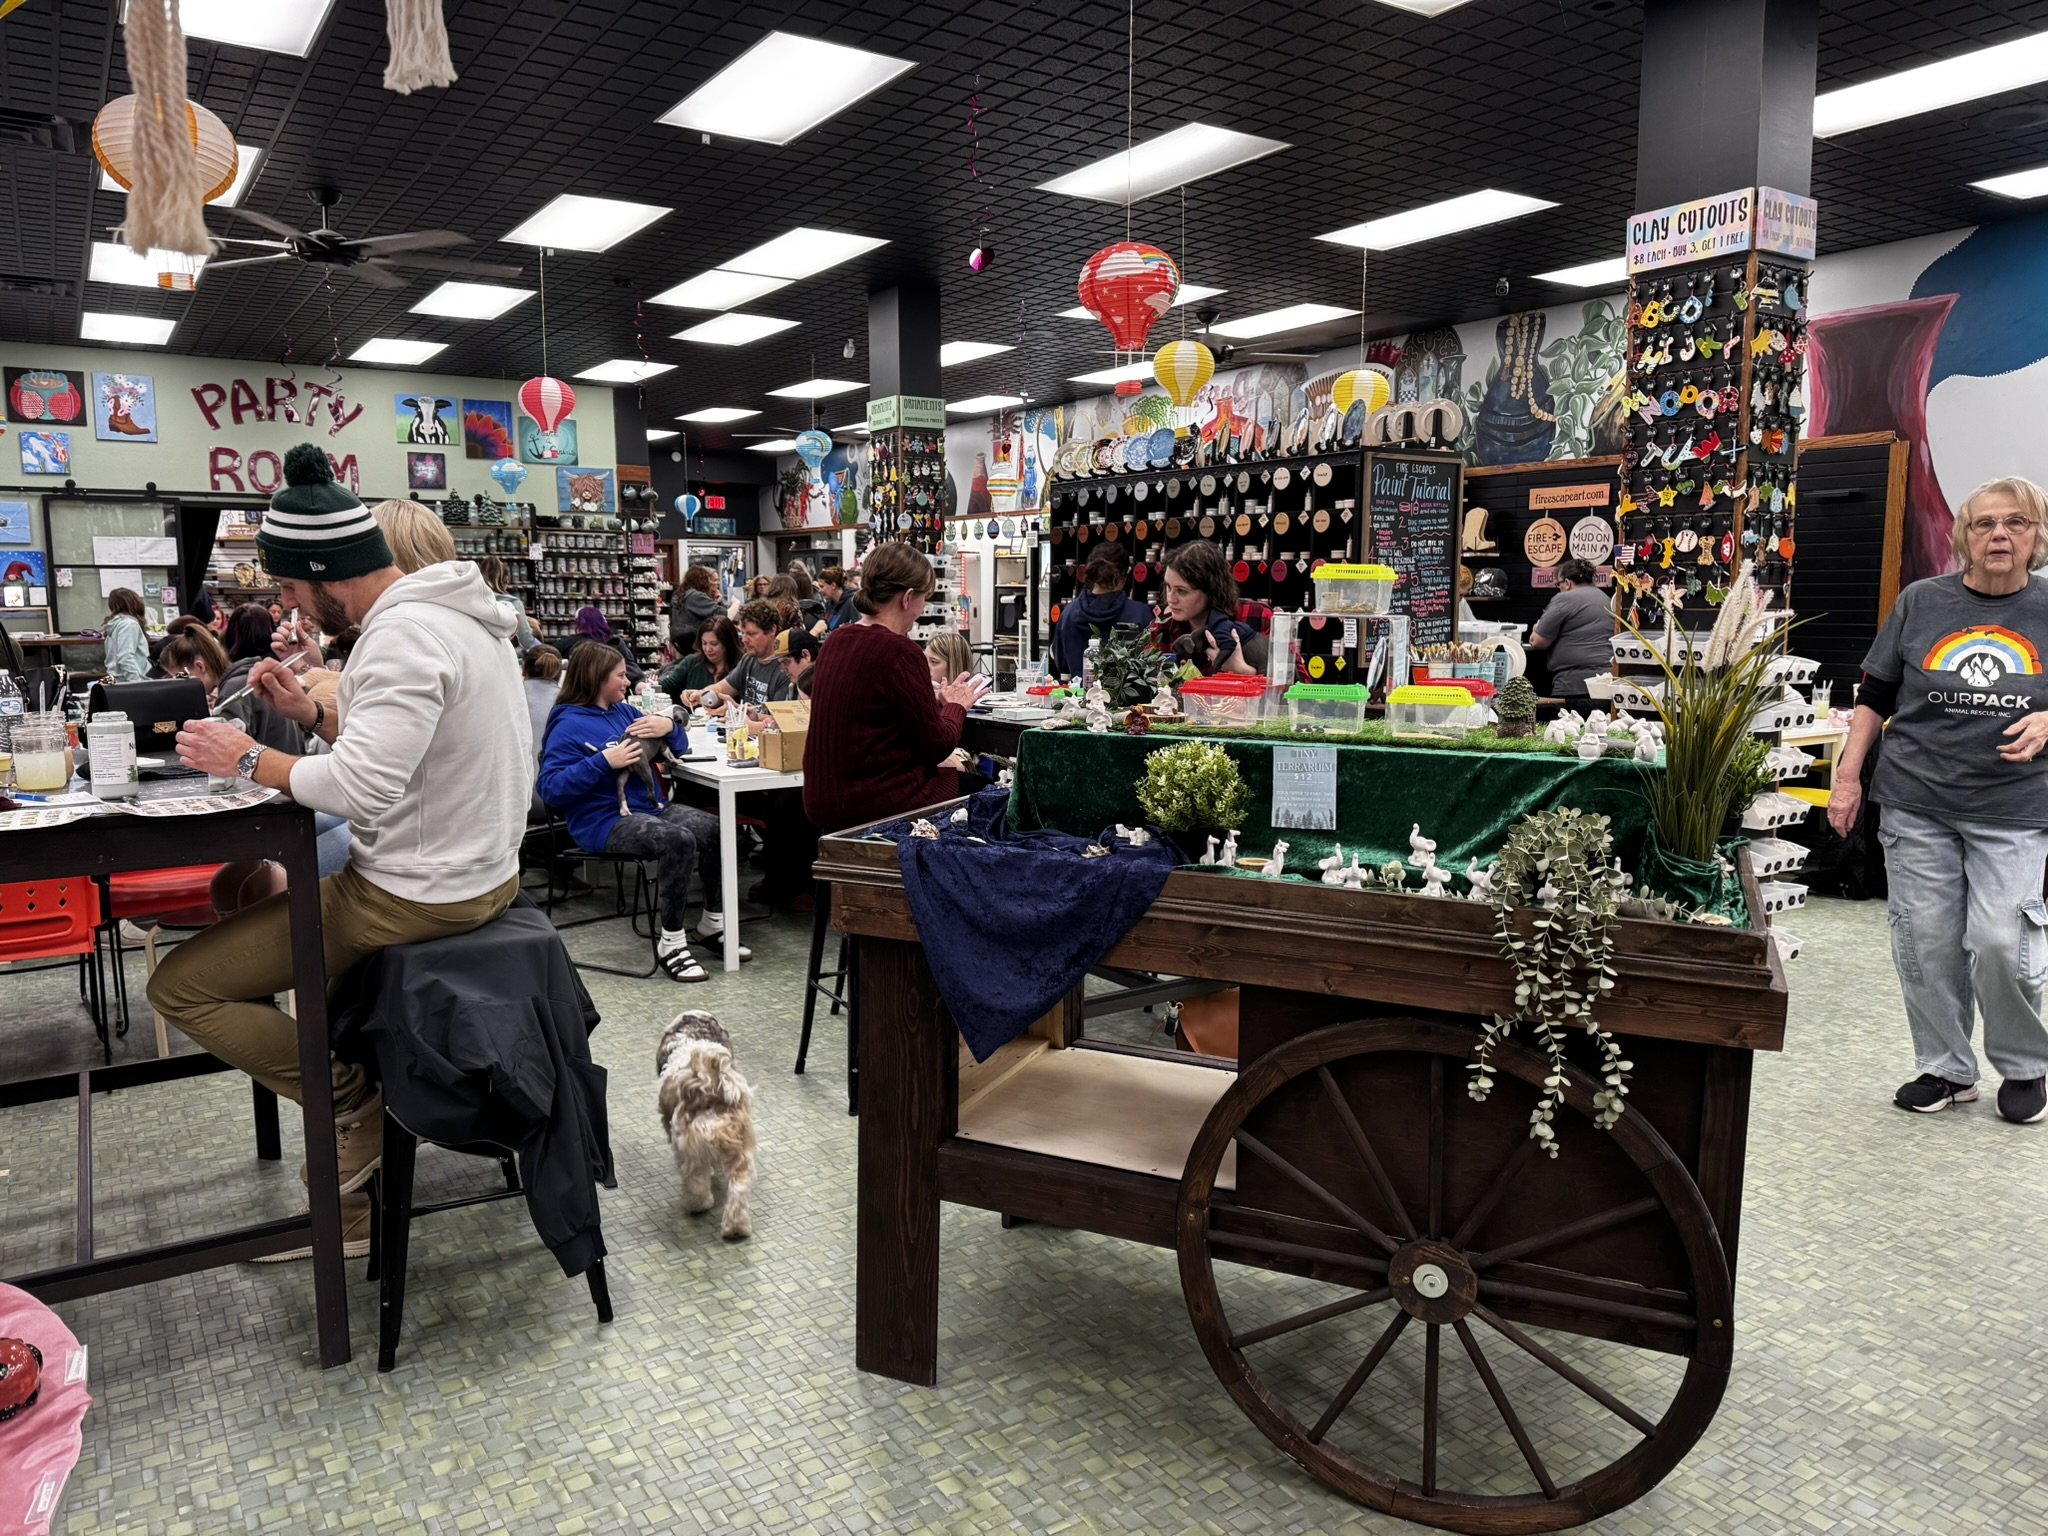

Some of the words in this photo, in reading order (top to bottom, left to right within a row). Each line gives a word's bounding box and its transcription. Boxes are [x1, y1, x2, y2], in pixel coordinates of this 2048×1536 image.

[1633, 215, 1670, 246] CLAY
[1678, 196, 1748, 235] CUTOUTS
[1763, 199, 1782, 223] CLAY
[1785, 203, 1816, 230] CUTOUTS
[1633, 253, 1645, 265] $8
[1647, 250, 1666, 263] EACH
[1673, 244, 1687, 258] BUY
[1702, 237, 1716, 251] GET
[1726, 231, 1745, 247] FREE
[190, 378, 364, 438] PARTY
[903, 398, 943, 412] ORNAMENTS
[209, 446, 360, 497] ROM
[1396, 463, 1409, 474] FIRE
[1373, 463, 1408, 497] Paint
[1409, 476, 1451, 501] Tutorial
[1535, 490, 1604, 504] fireescapeart.com
[1398, 516, 1407, 529] 2
[1401, 536, 1409, 551] 3
[1572, 532, 1594, 543] MUD
[1595, 533, 1611, 543] ON
[1528, 543, 1562, 555] ESCAPE
[1572, 543, 1598, 553] MAIN
[1410, 571, 1420, 587] 5
[1409, 620, 1417, 638] 8
[1928, 691, 2032, 709] OURPACK
[1944, 707, 1970, 715] ANIMAL
[1970, 709, 1997, 717] RESCUE,
[1295, 749, 1317, 759] TINY
